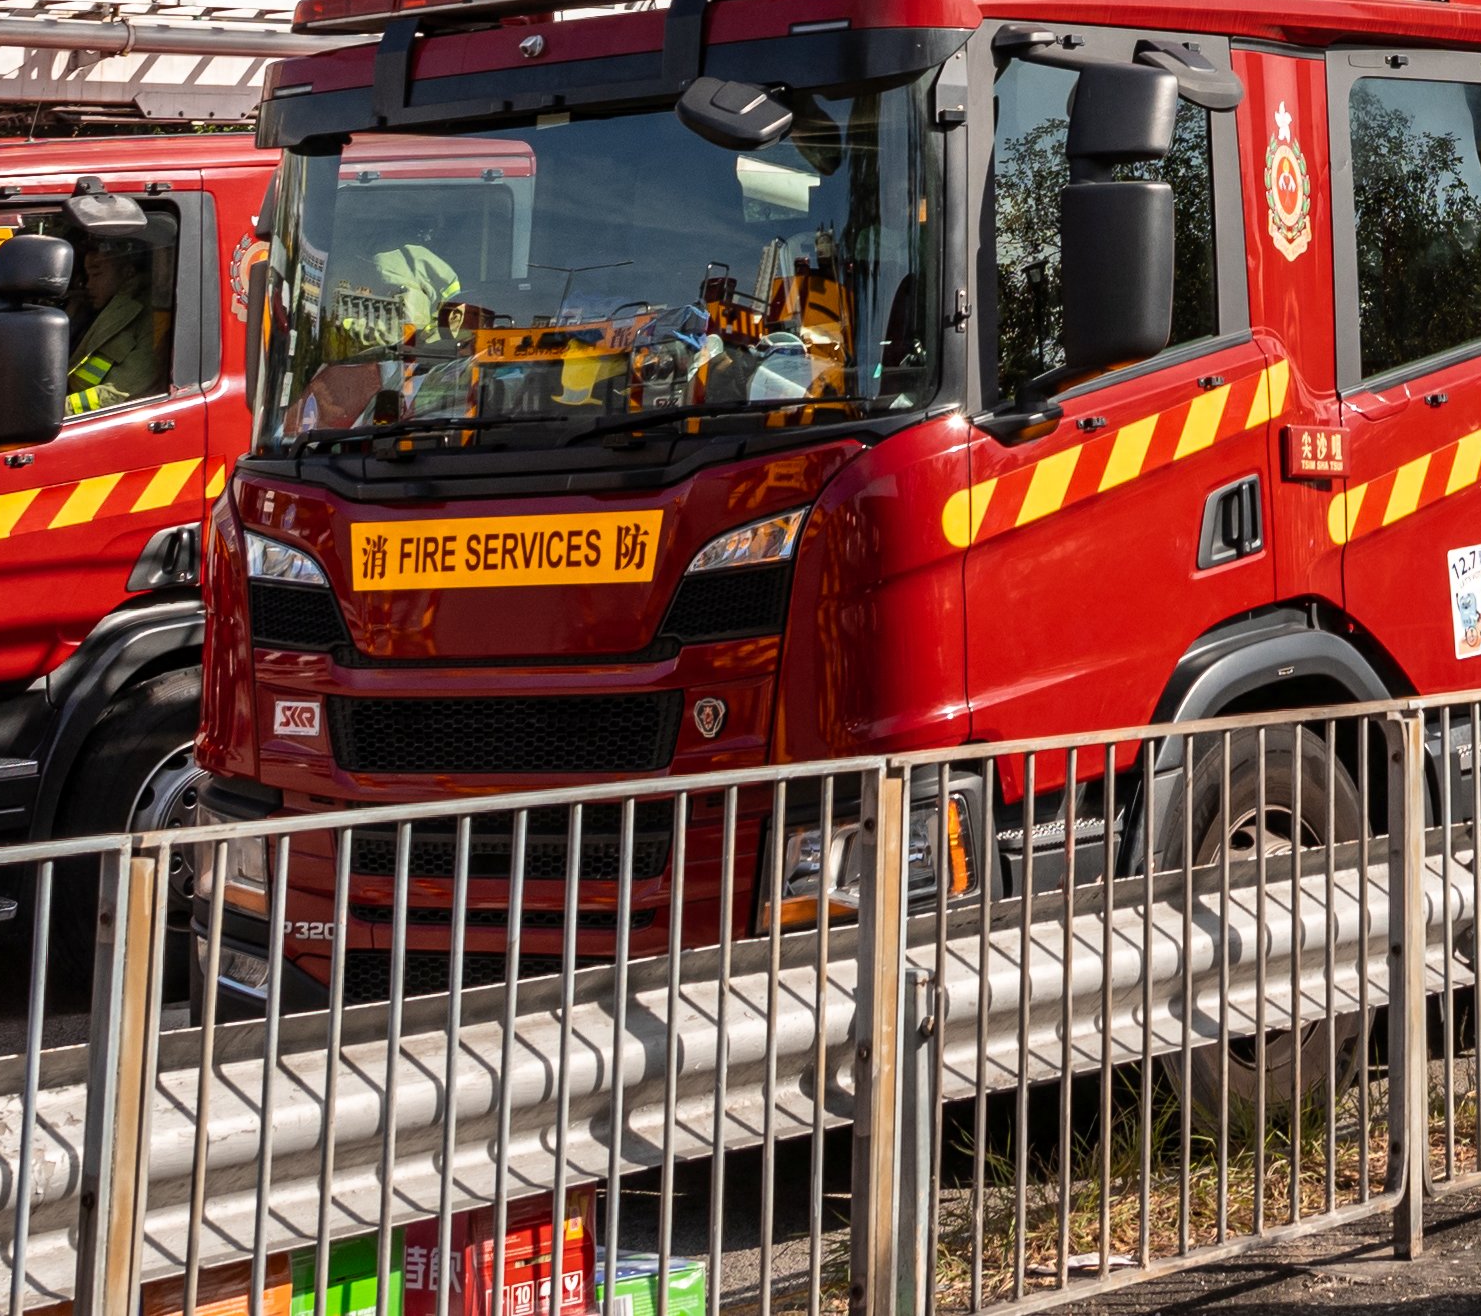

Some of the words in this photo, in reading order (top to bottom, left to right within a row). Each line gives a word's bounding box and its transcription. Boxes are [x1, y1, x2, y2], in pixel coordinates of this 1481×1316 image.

[1301, 431, 1343, 460] 尖沙咀
[361, 534, 388, 580] 消
[398, 535, 458, 575] FIRE
[464, 528, 603, 572] SERVICES
[614, 522, 650, 571] 防
[1451, 550, 1476, 579] 12.7
[295, 921, 335, 940] 320
[515, 1284, 531, 1305] 10
